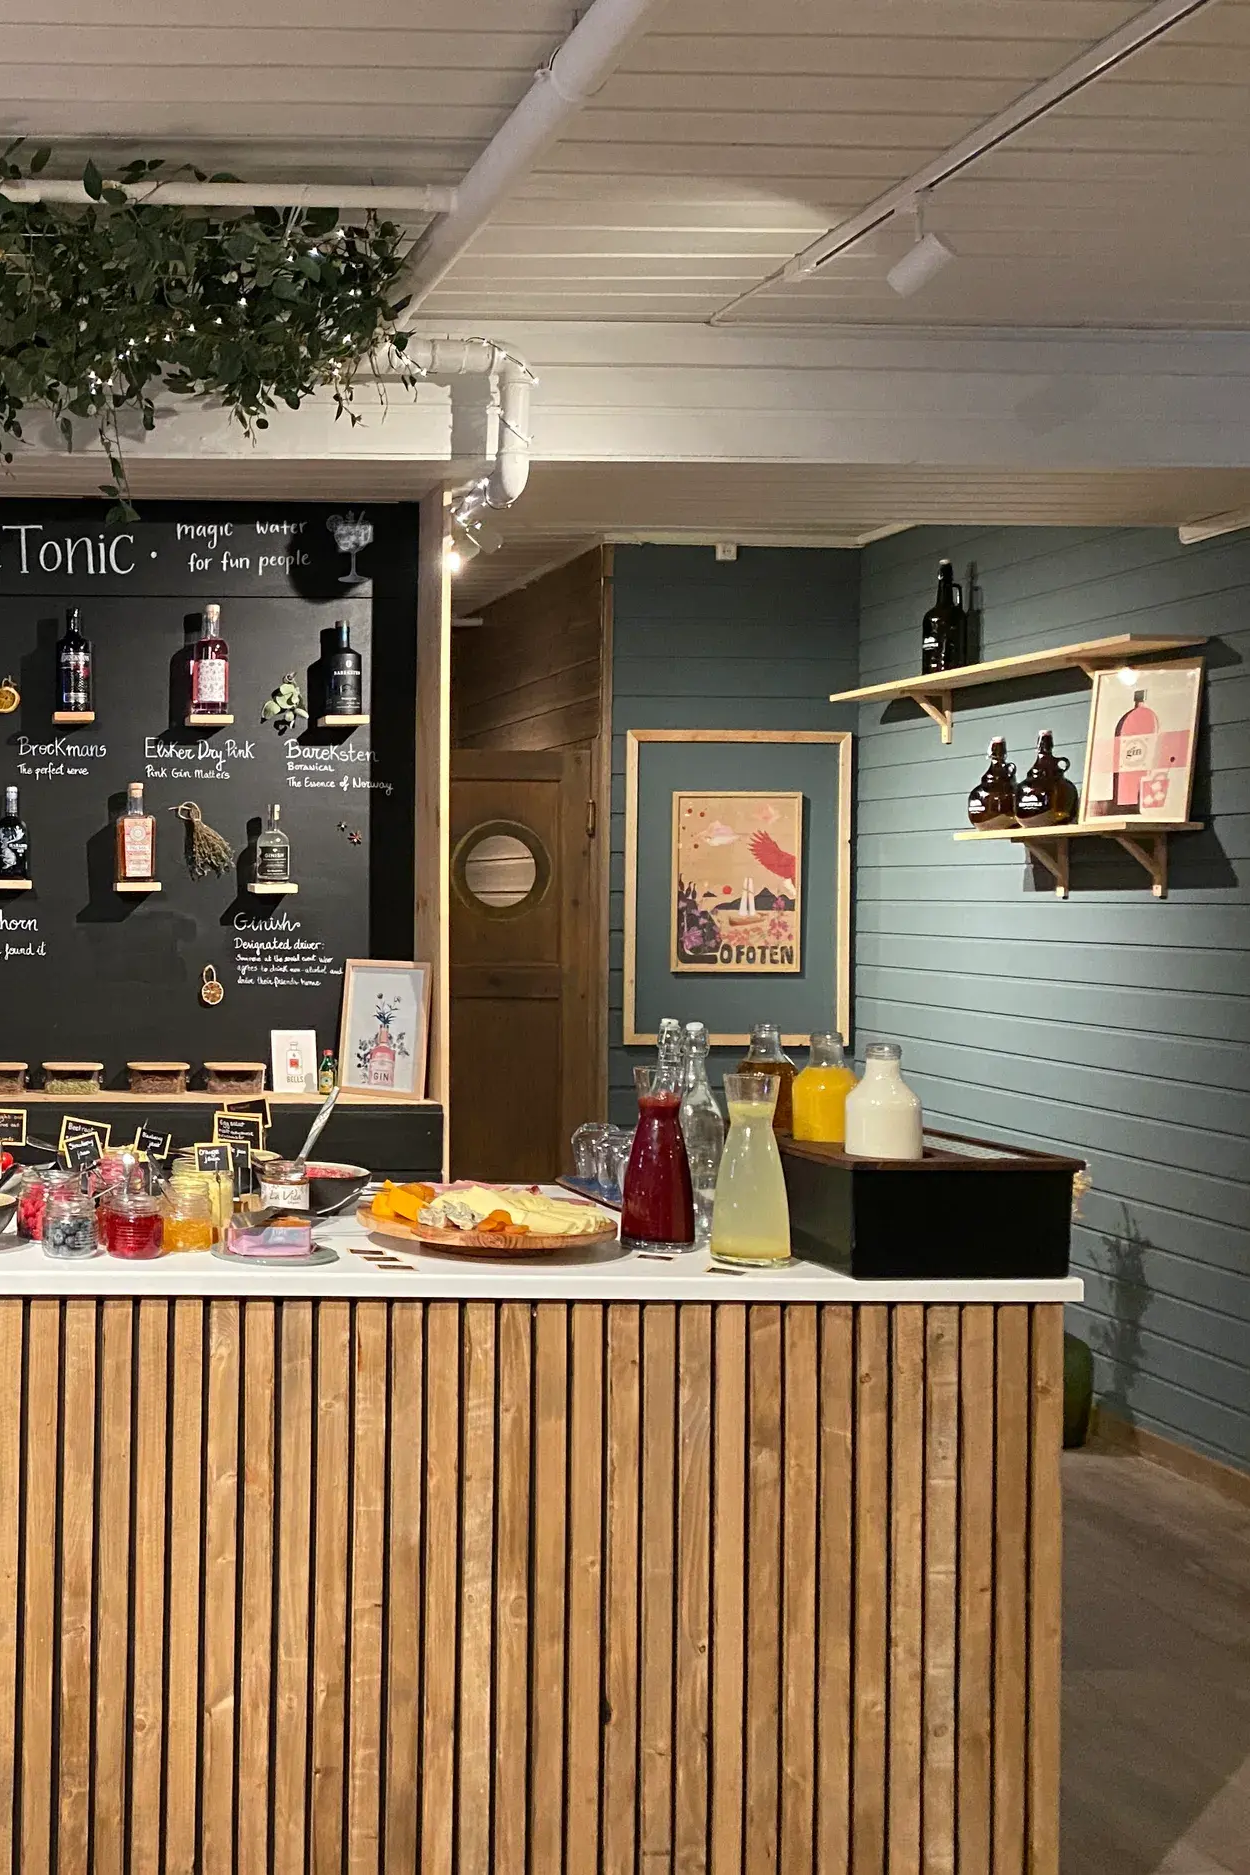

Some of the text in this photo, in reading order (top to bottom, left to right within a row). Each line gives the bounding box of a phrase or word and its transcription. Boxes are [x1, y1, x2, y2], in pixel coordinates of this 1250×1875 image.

[176, 520, 308, 549] magic water
[2, 525, 136, 575] Tonic
[188, 549, 312, 576] for fun people
[197, 739, 226, 771] Dry
[17, 763, 32, 775] The
[35, 763, 64, 780] perfect
[171, 768, 191, 778] Gin
[286, 775, 394, 796] The Essence of Norway
[234, 937, 292, 956] Designated
[373, 1072, 390, 1081] GIN
